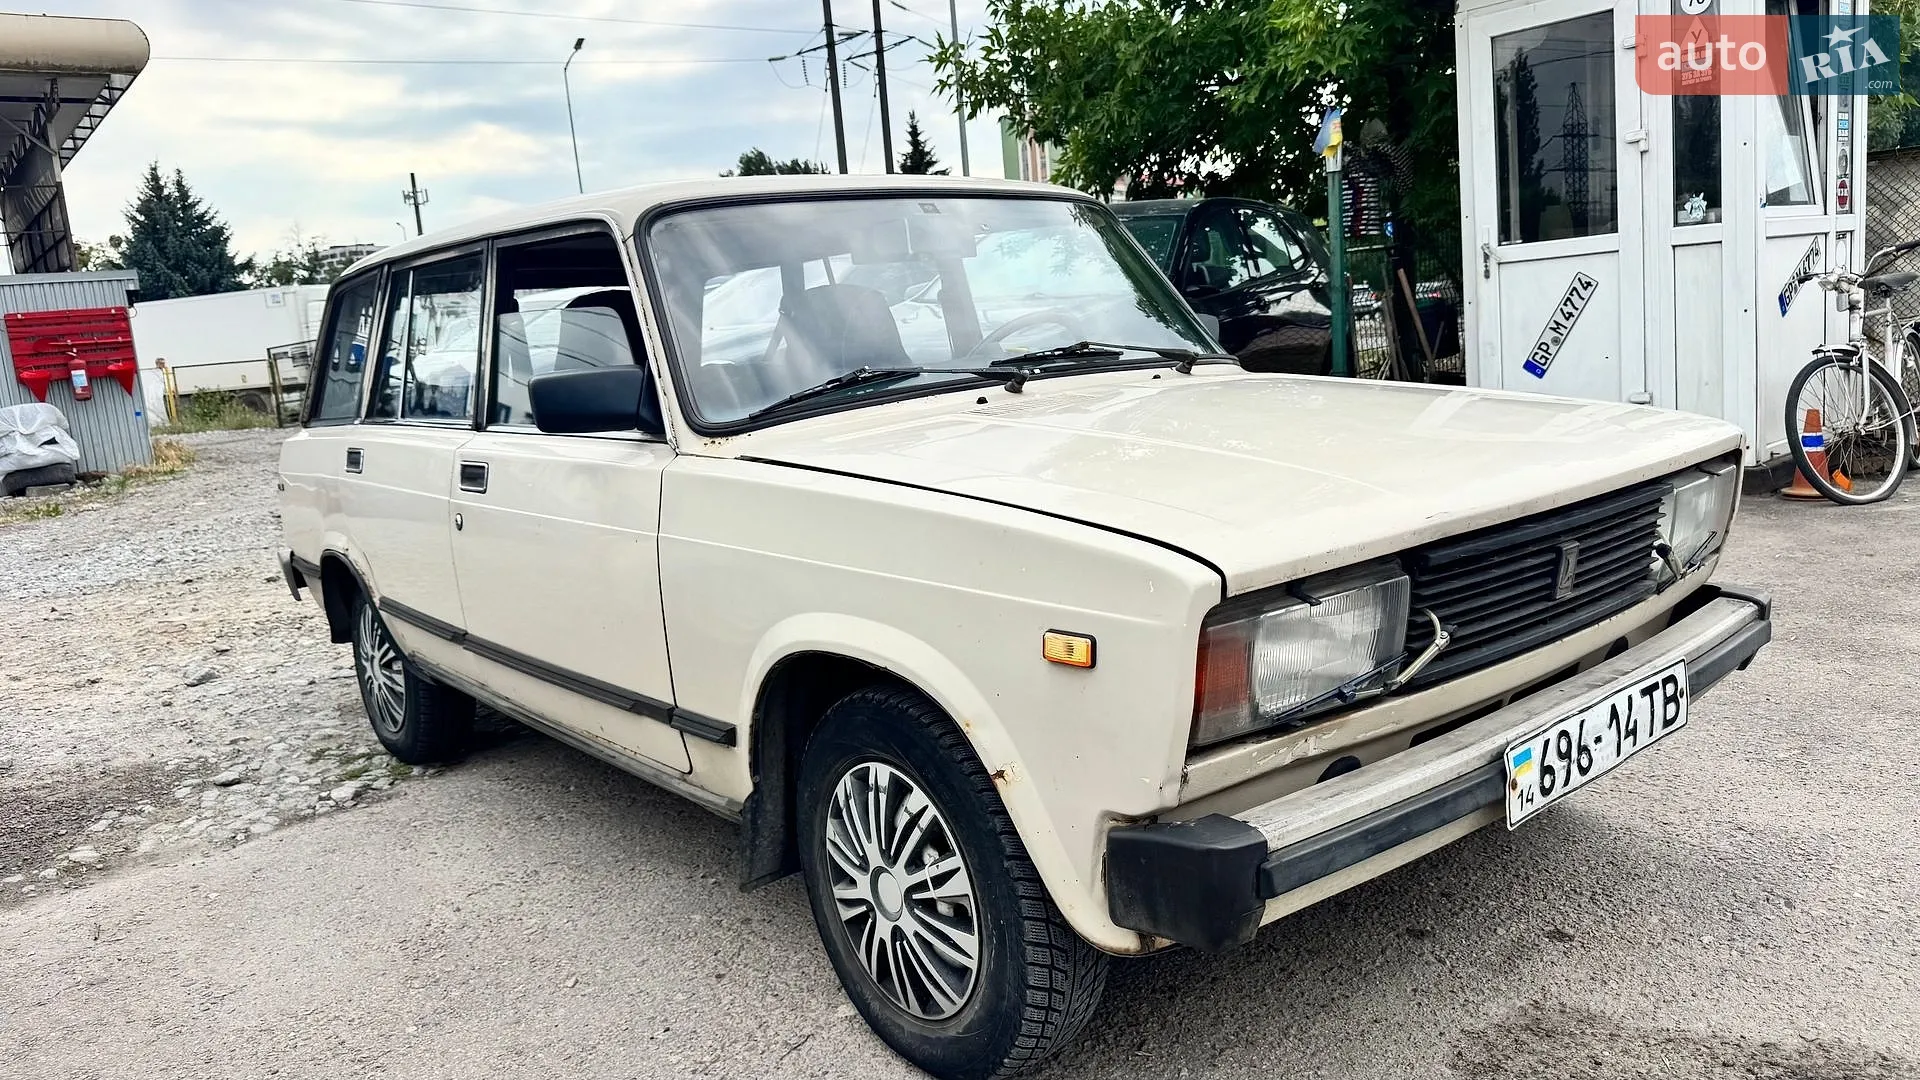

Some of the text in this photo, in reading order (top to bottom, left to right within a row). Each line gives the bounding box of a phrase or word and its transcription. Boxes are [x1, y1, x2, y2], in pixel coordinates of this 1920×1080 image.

[1531, 341, 1552, 367] GP
[1548, 319, 1568, 337] M
[1560, 277, 1594, 321] 4774
[1517, 783, 1535, 812] 14
